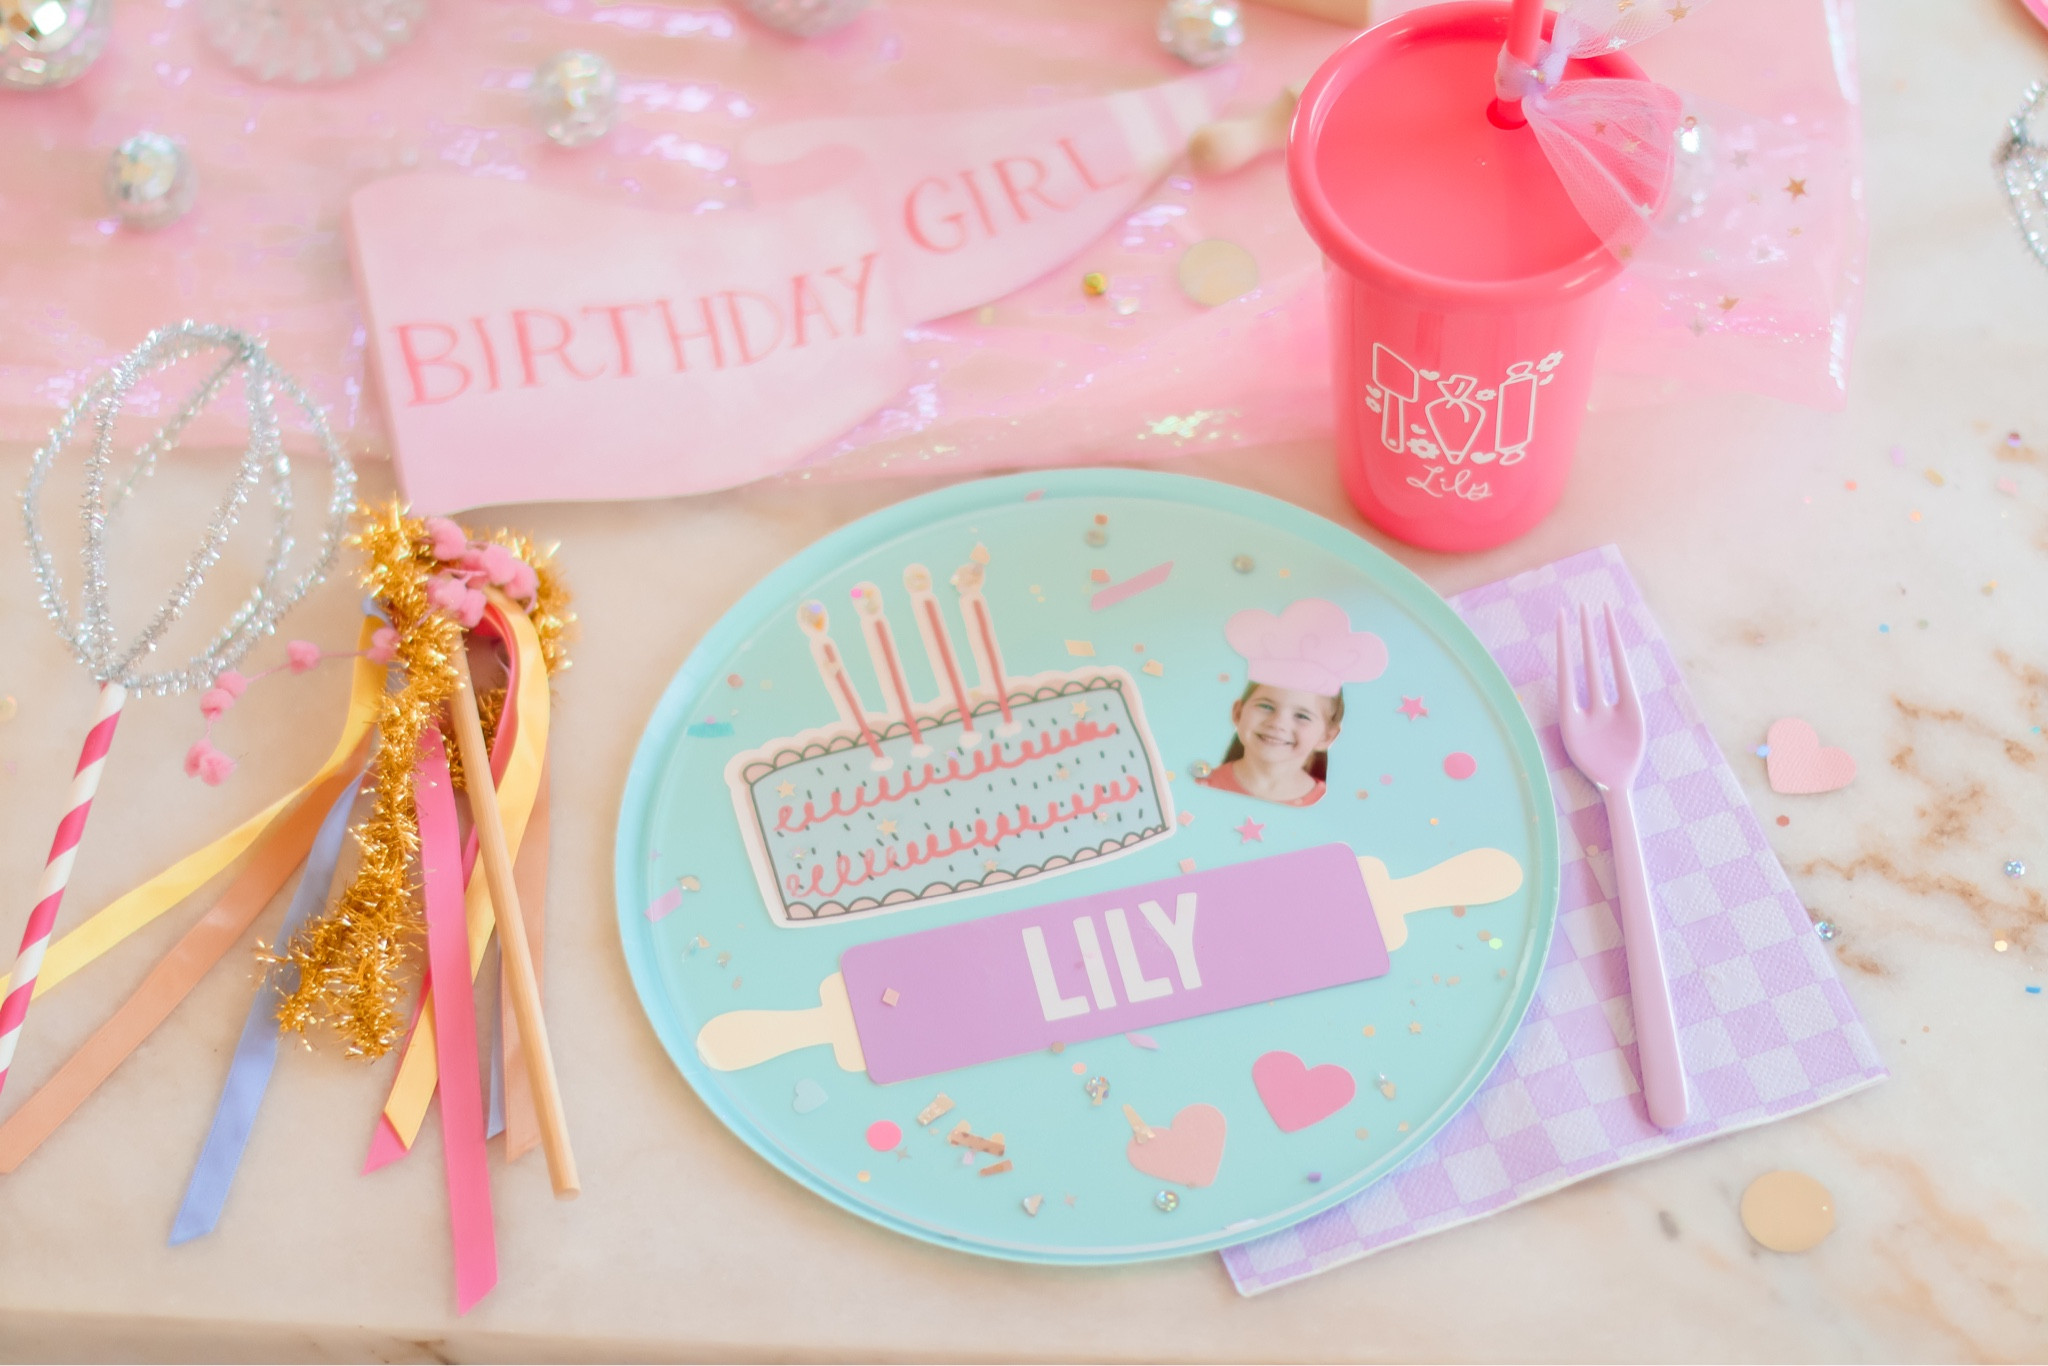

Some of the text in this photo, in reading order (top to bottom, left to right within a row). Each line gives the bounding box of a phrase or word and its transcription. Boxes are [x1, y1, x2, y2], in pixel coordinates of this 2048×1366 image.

[389, 136, 1129, 408] BIRTHDAY GIRL
[1405, 464, 1493, 501] Lily
[1021, 892, 1203, 1021] LILY
